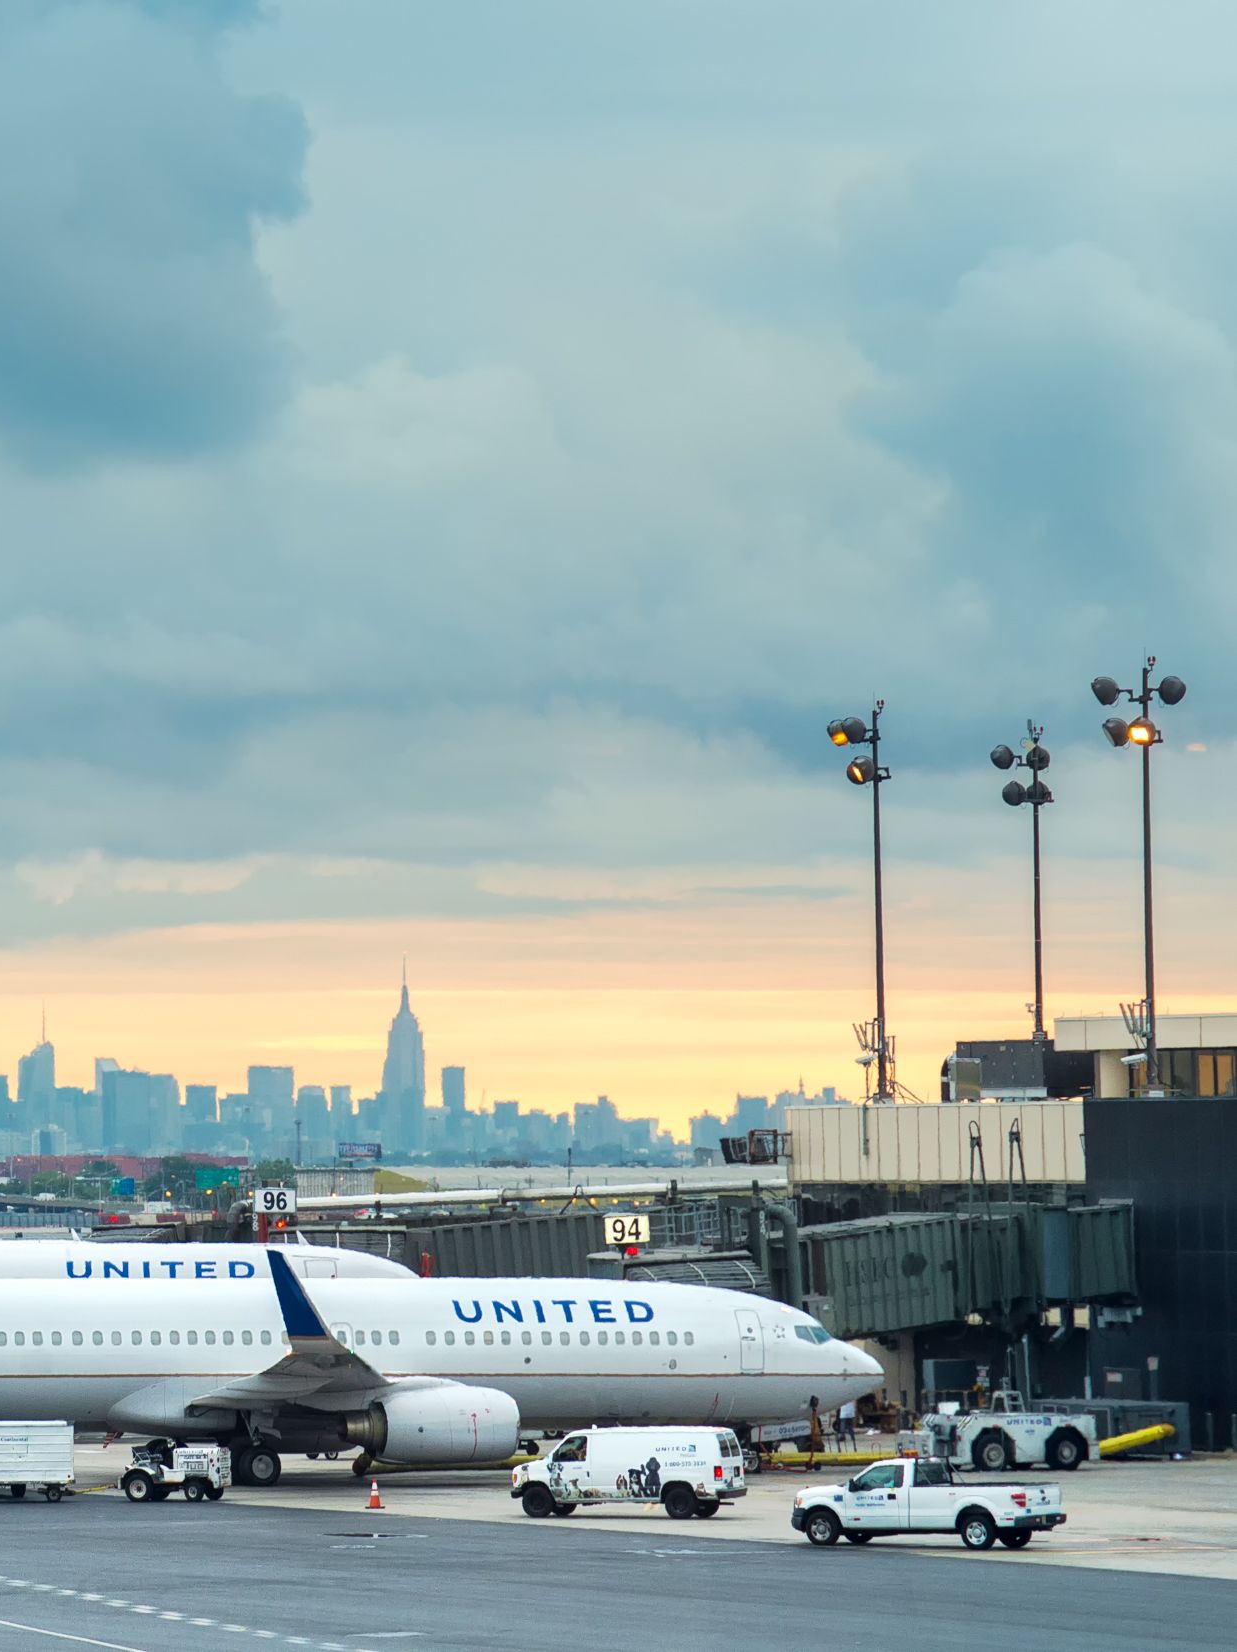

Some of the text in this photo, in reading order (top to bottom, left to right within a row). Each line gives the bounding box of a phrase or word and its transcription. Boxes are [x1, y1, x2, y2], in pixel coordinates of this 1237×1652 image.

[263, 1191, 287, 1210] 96
[612, 1218, 641, 1241] 94
[66, 1260, 256, 1279] UNITED
[452, 1300, 654, 1323] UNITED
